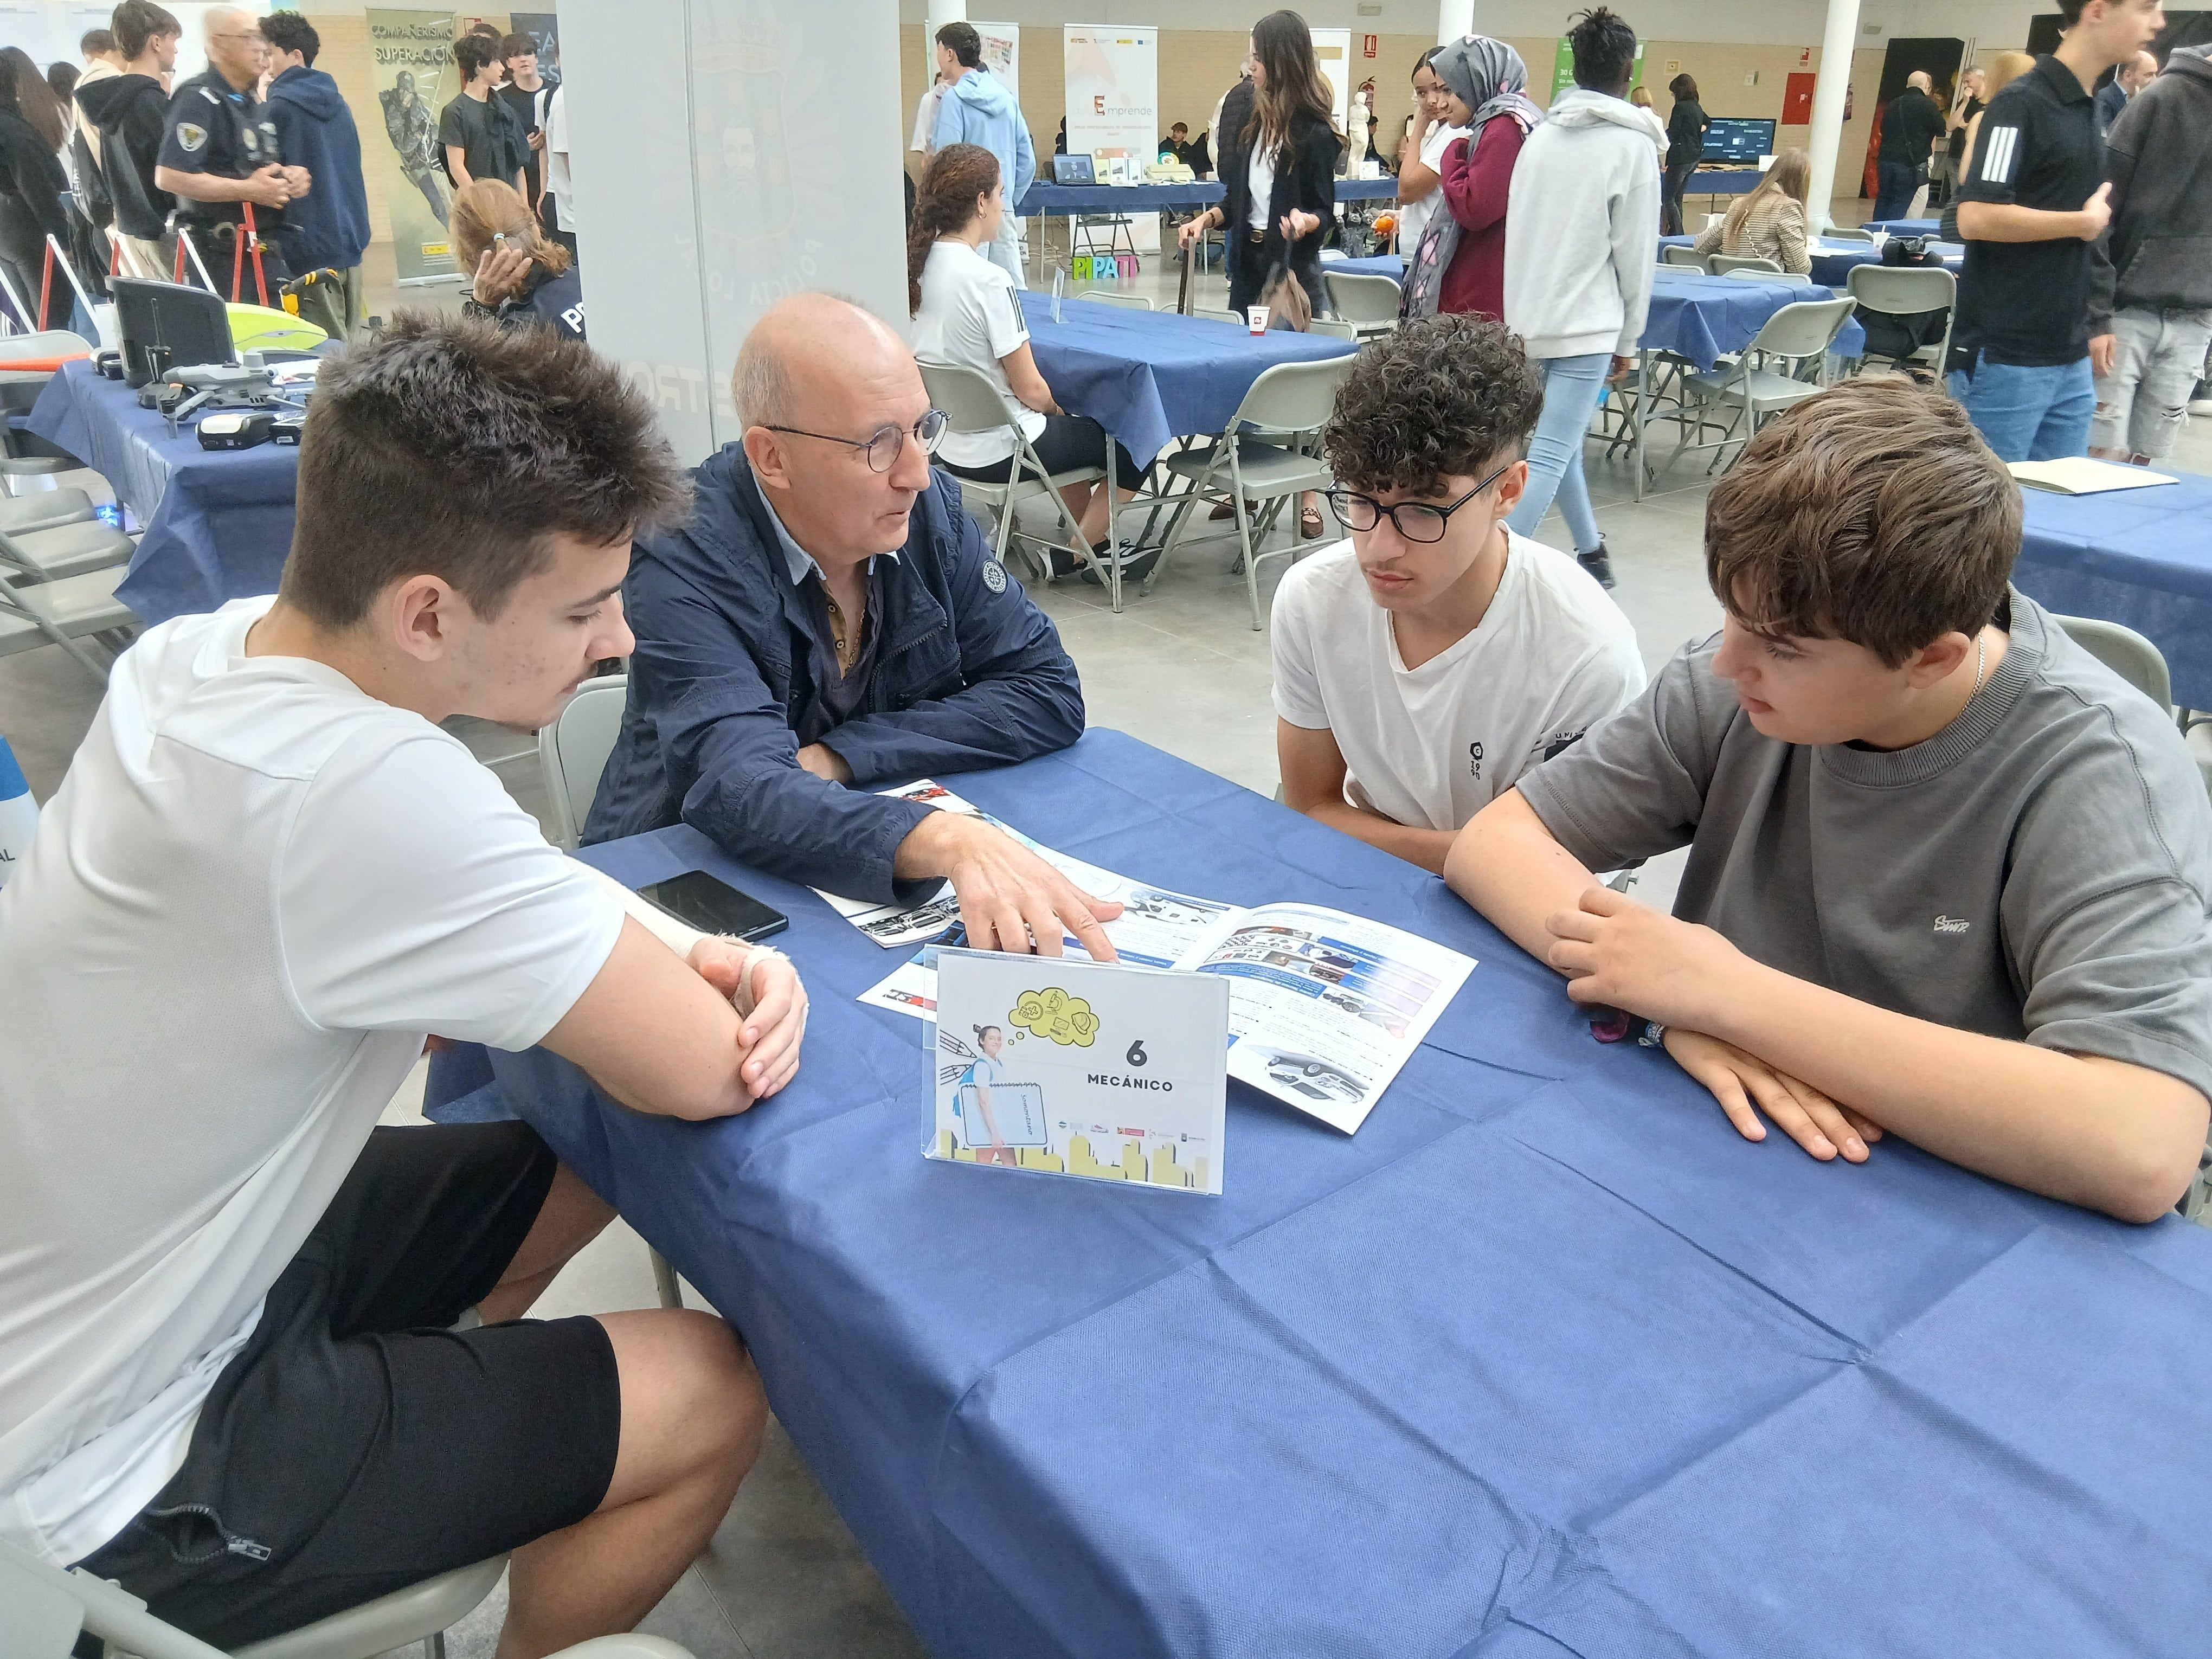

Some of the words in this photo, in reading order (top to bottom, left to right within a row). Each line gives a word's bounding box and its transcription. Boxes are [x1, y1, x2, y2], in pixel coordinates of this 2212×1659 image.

[371, 24, 453, 38] COMPAÑERISMO
[375, 44, 455, 62] SUPERACIÓN
[1072, 255, 1137, 280] PIPATI
[1127, 1040, 1147, 1066] 6
[1088, 1073, 1173, 1092] MECÁNICO
